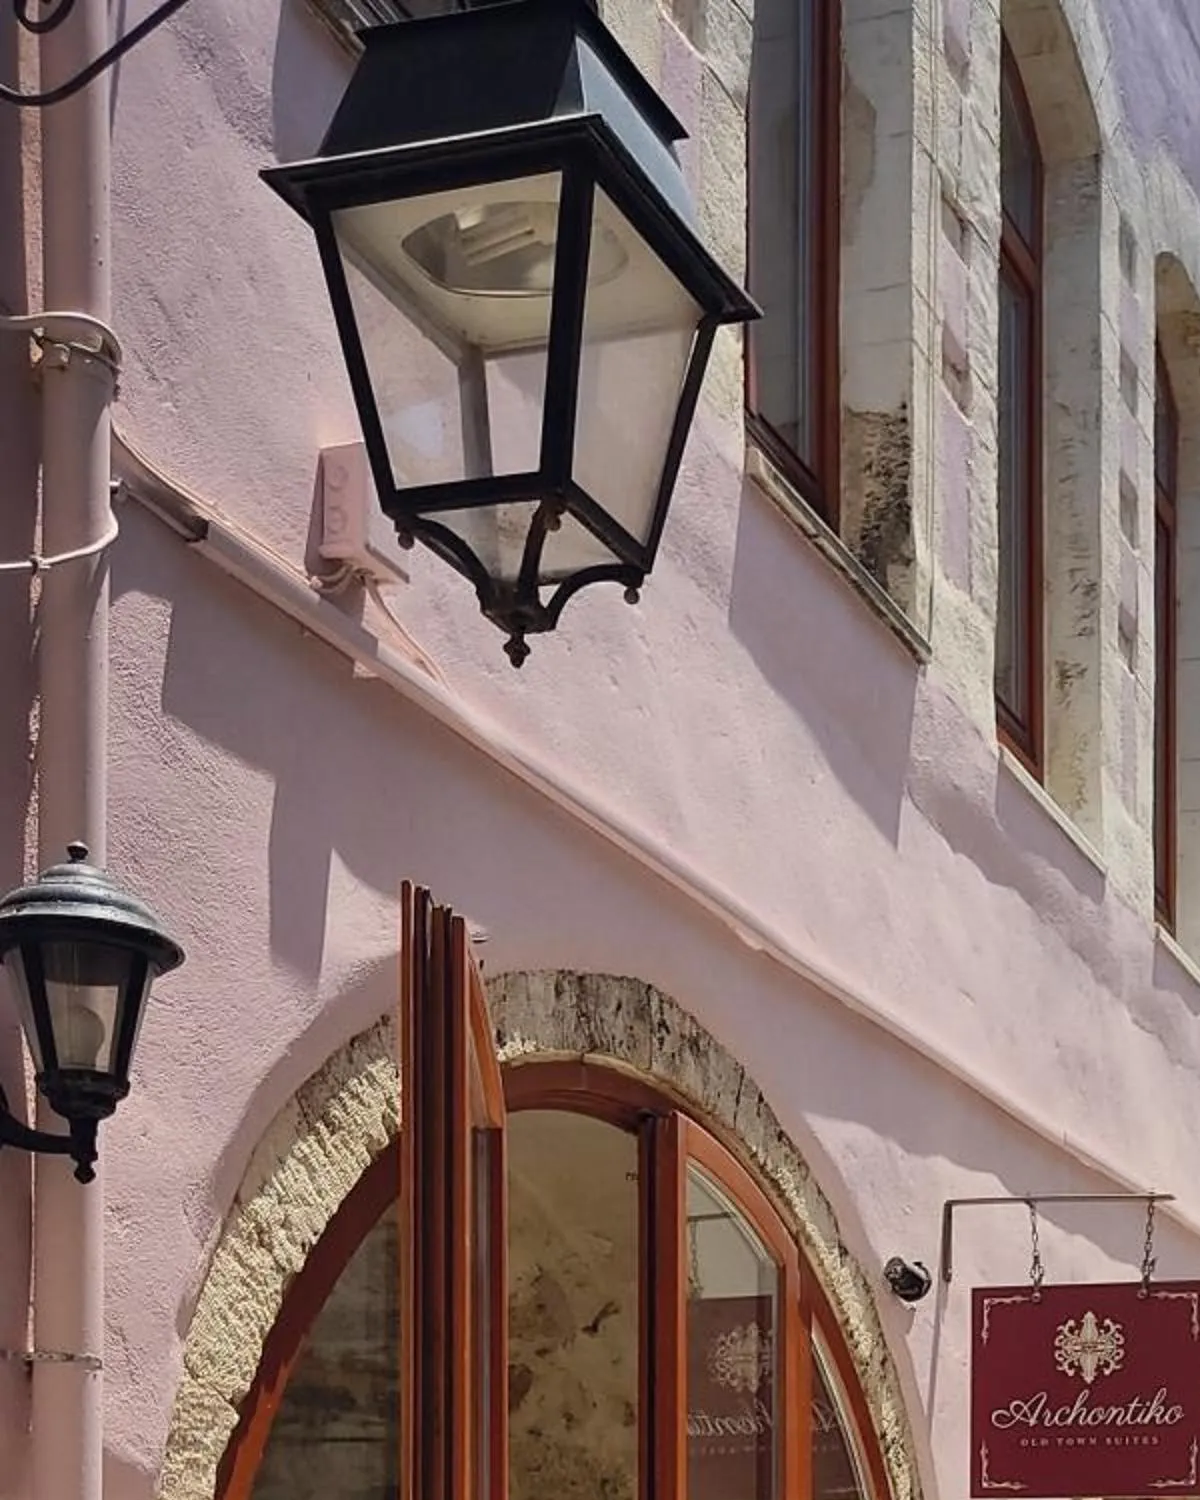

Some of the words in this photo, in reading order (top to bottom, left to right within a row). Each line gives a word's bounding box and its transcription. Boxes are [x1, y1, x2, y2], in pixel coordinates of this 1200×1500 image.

[991, 1388, 1185, 1428] Archontiko
[1021, 1438, 1049, 1447] OLD
[1056, 1437, 1097, 1447] TOWN
[1105, 1436, 1159, 1446] SUITES
